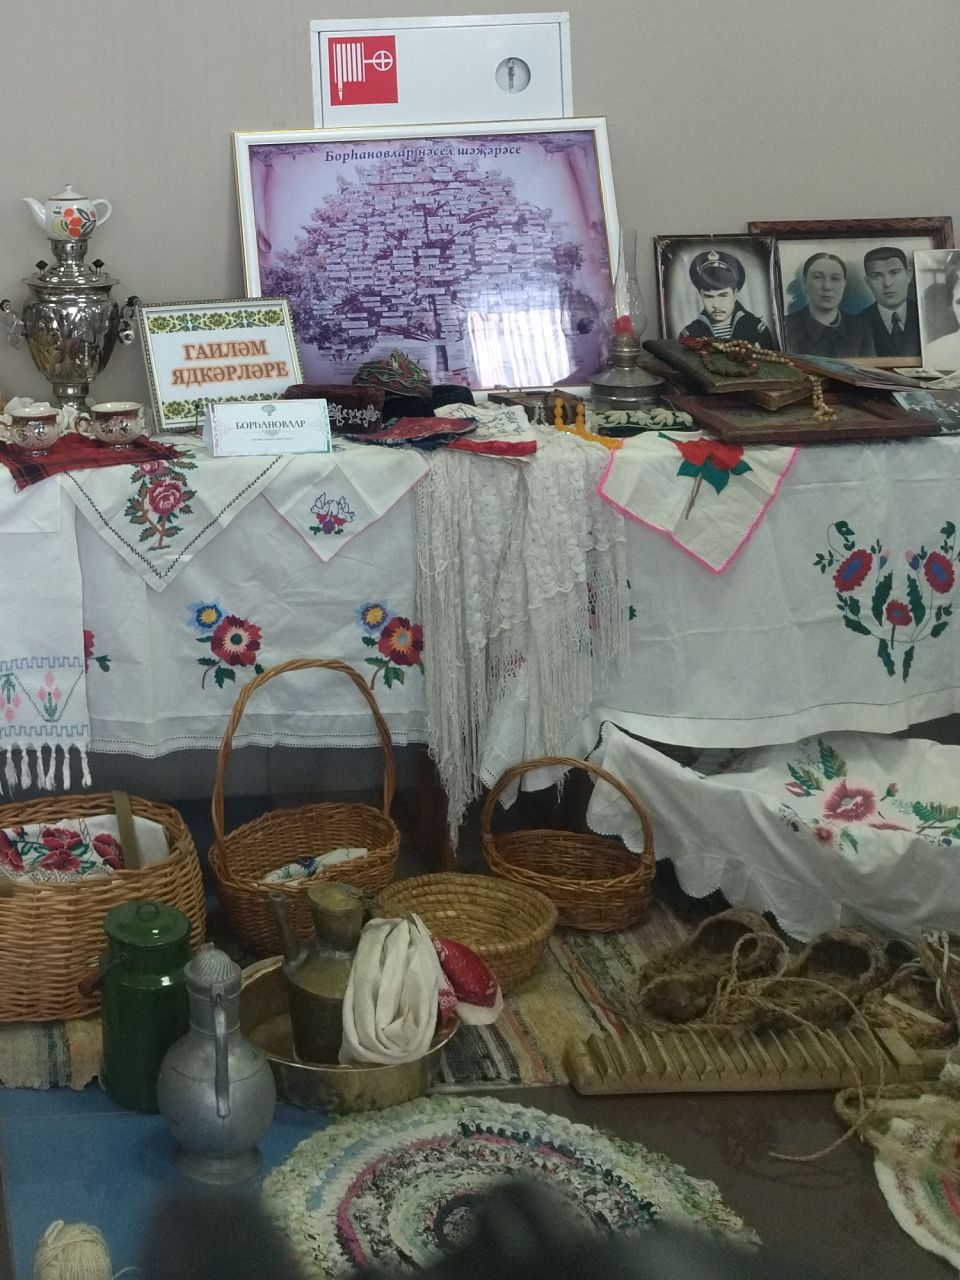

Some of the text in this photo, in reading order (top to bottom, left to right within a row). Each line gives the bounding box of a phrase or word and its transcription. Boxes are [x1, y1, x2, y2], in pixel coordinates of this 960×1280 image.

[417, 146, 454, 158] нәсел
[183, 340, 268, 360] ГАИЛӘМ
[172, 362, 288, 386] ЯДКӘРЛӘРЕ
